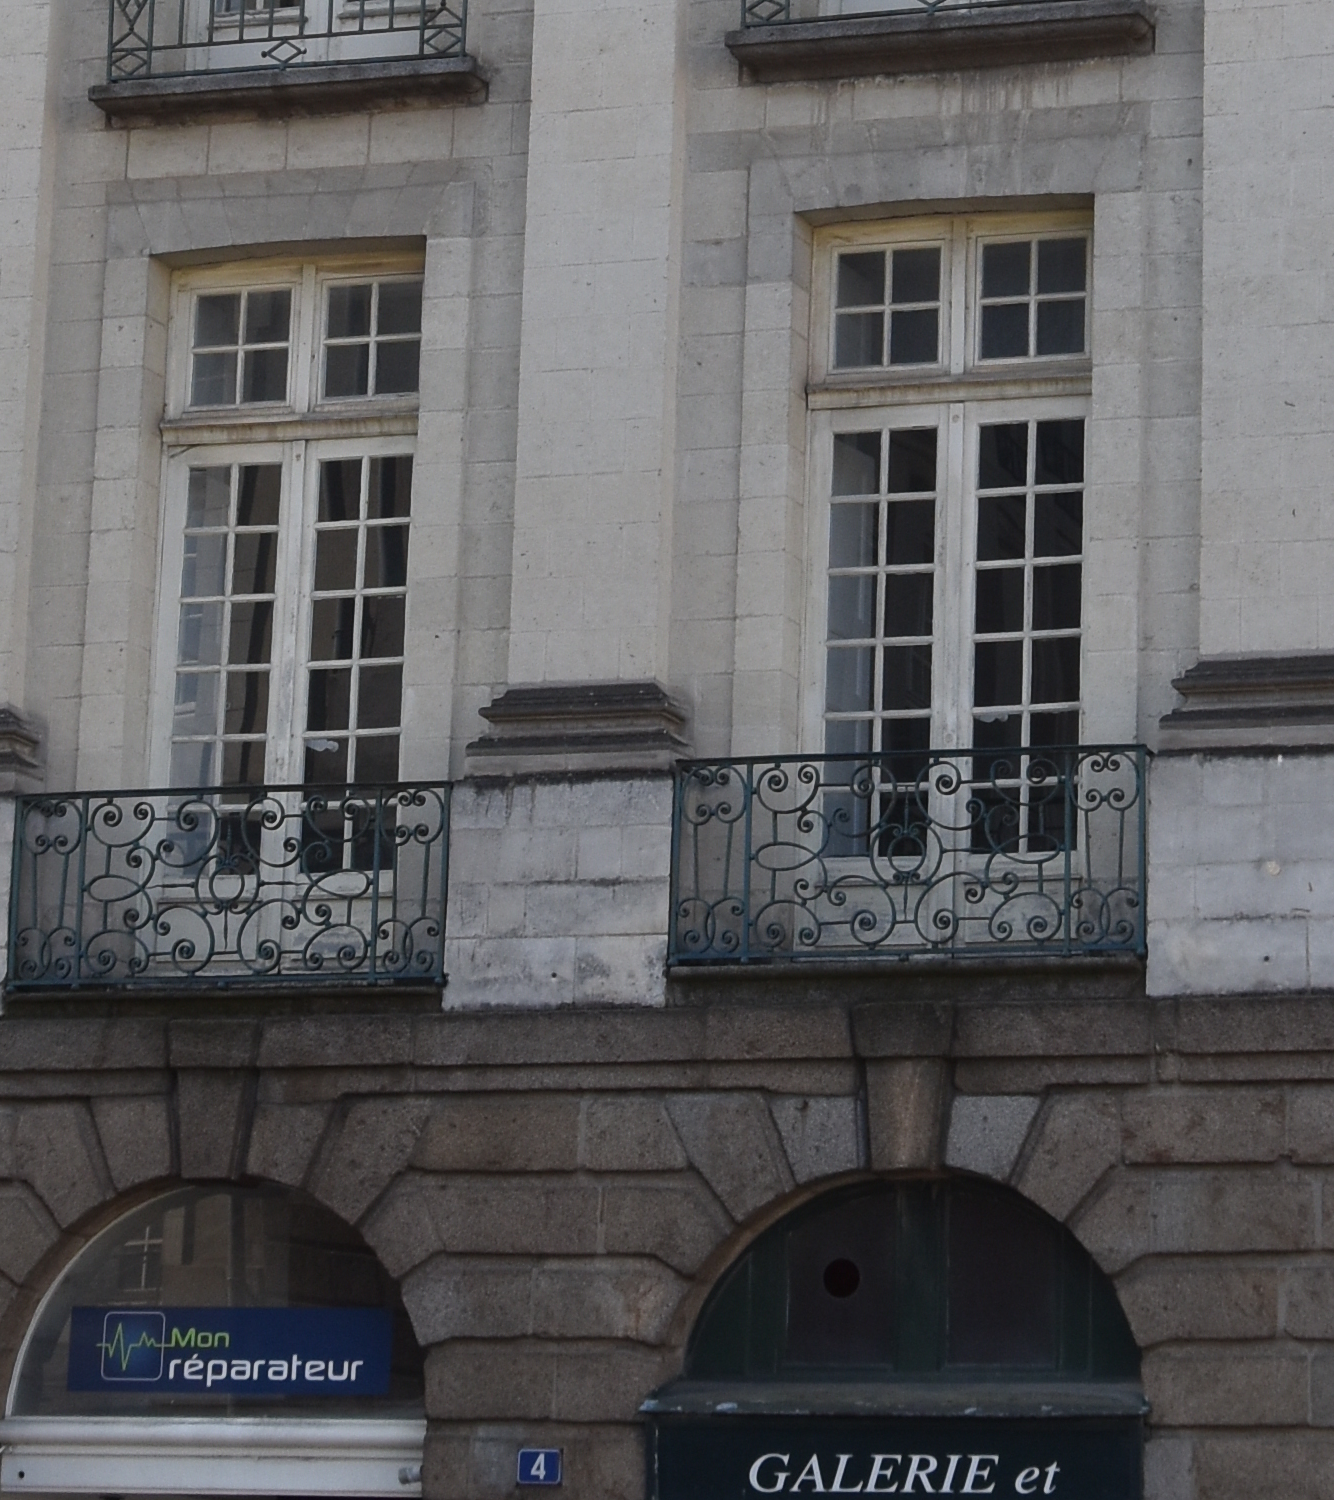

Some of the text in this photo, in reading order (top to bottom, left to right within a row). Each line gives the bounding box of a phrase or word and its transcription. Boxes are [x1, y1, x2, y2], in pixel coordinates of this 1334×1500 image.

[170, 1327, 230, 1348] Mon
[168, 1353, 364, 1387] réparateur
[530, 1453, 546, 1480] 4
[748, 1453, 1061, 1494] GALERIE et
